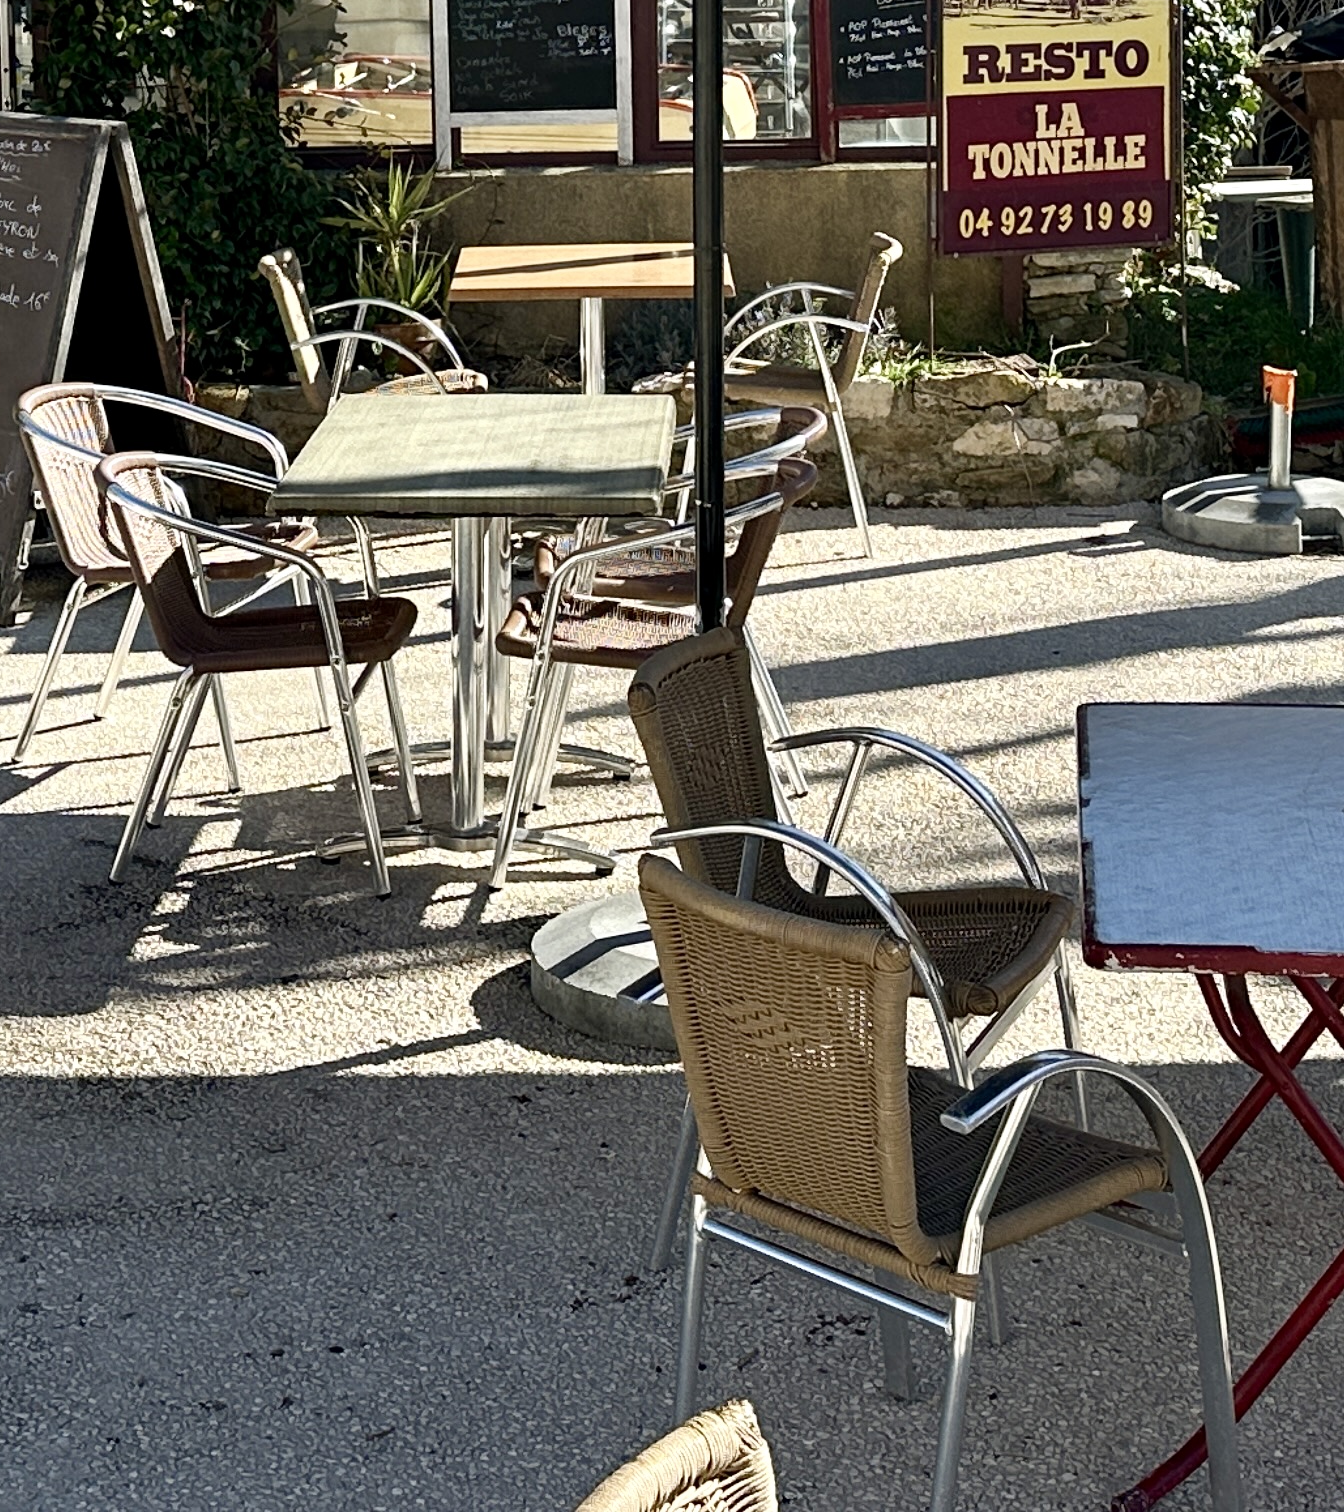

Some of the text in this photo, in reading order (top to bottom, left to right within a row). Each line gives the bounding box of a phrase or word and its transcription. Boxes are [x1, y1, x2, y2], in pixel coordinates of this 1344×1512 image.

[963, 39, 1150, 85] RESTO
[1035, 101, 1085, 139] LA
[968, 134, 1147, 180] TONNELLE
[26, 195, 42, 218] de
[959, 198, 1153, 239] 04 92 73 19 89
